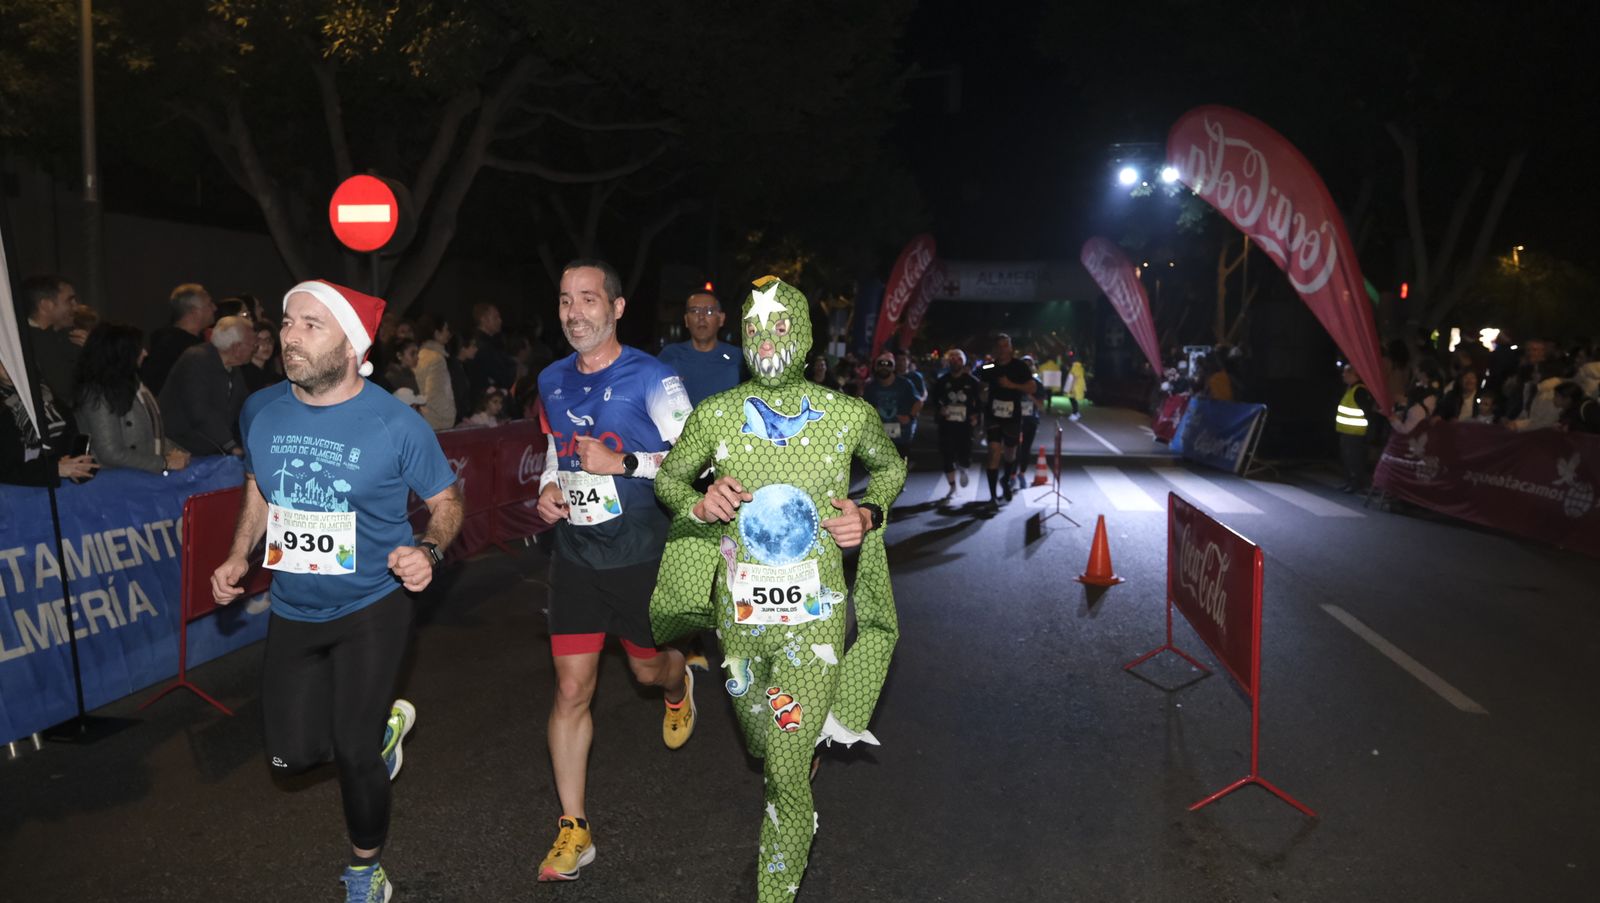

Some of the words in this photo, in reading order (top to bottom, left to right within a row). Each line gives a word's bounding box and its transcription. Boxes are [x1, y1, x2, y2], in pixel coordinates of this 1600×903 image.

[270, 445, 297, 454] CIUDAD
[298, 446, 309, 455] DE
[272, 435, 285, 444] XIV
[286, 435, 301, 445] SAN
[303, 436, 345, 453] SILVESTRE
[568, 488, 601, 506] 524
[283, 531, 335, 553] 930
[0, 516, 183, 597] TAMIENT
[753, 586, 802, 605] 506
